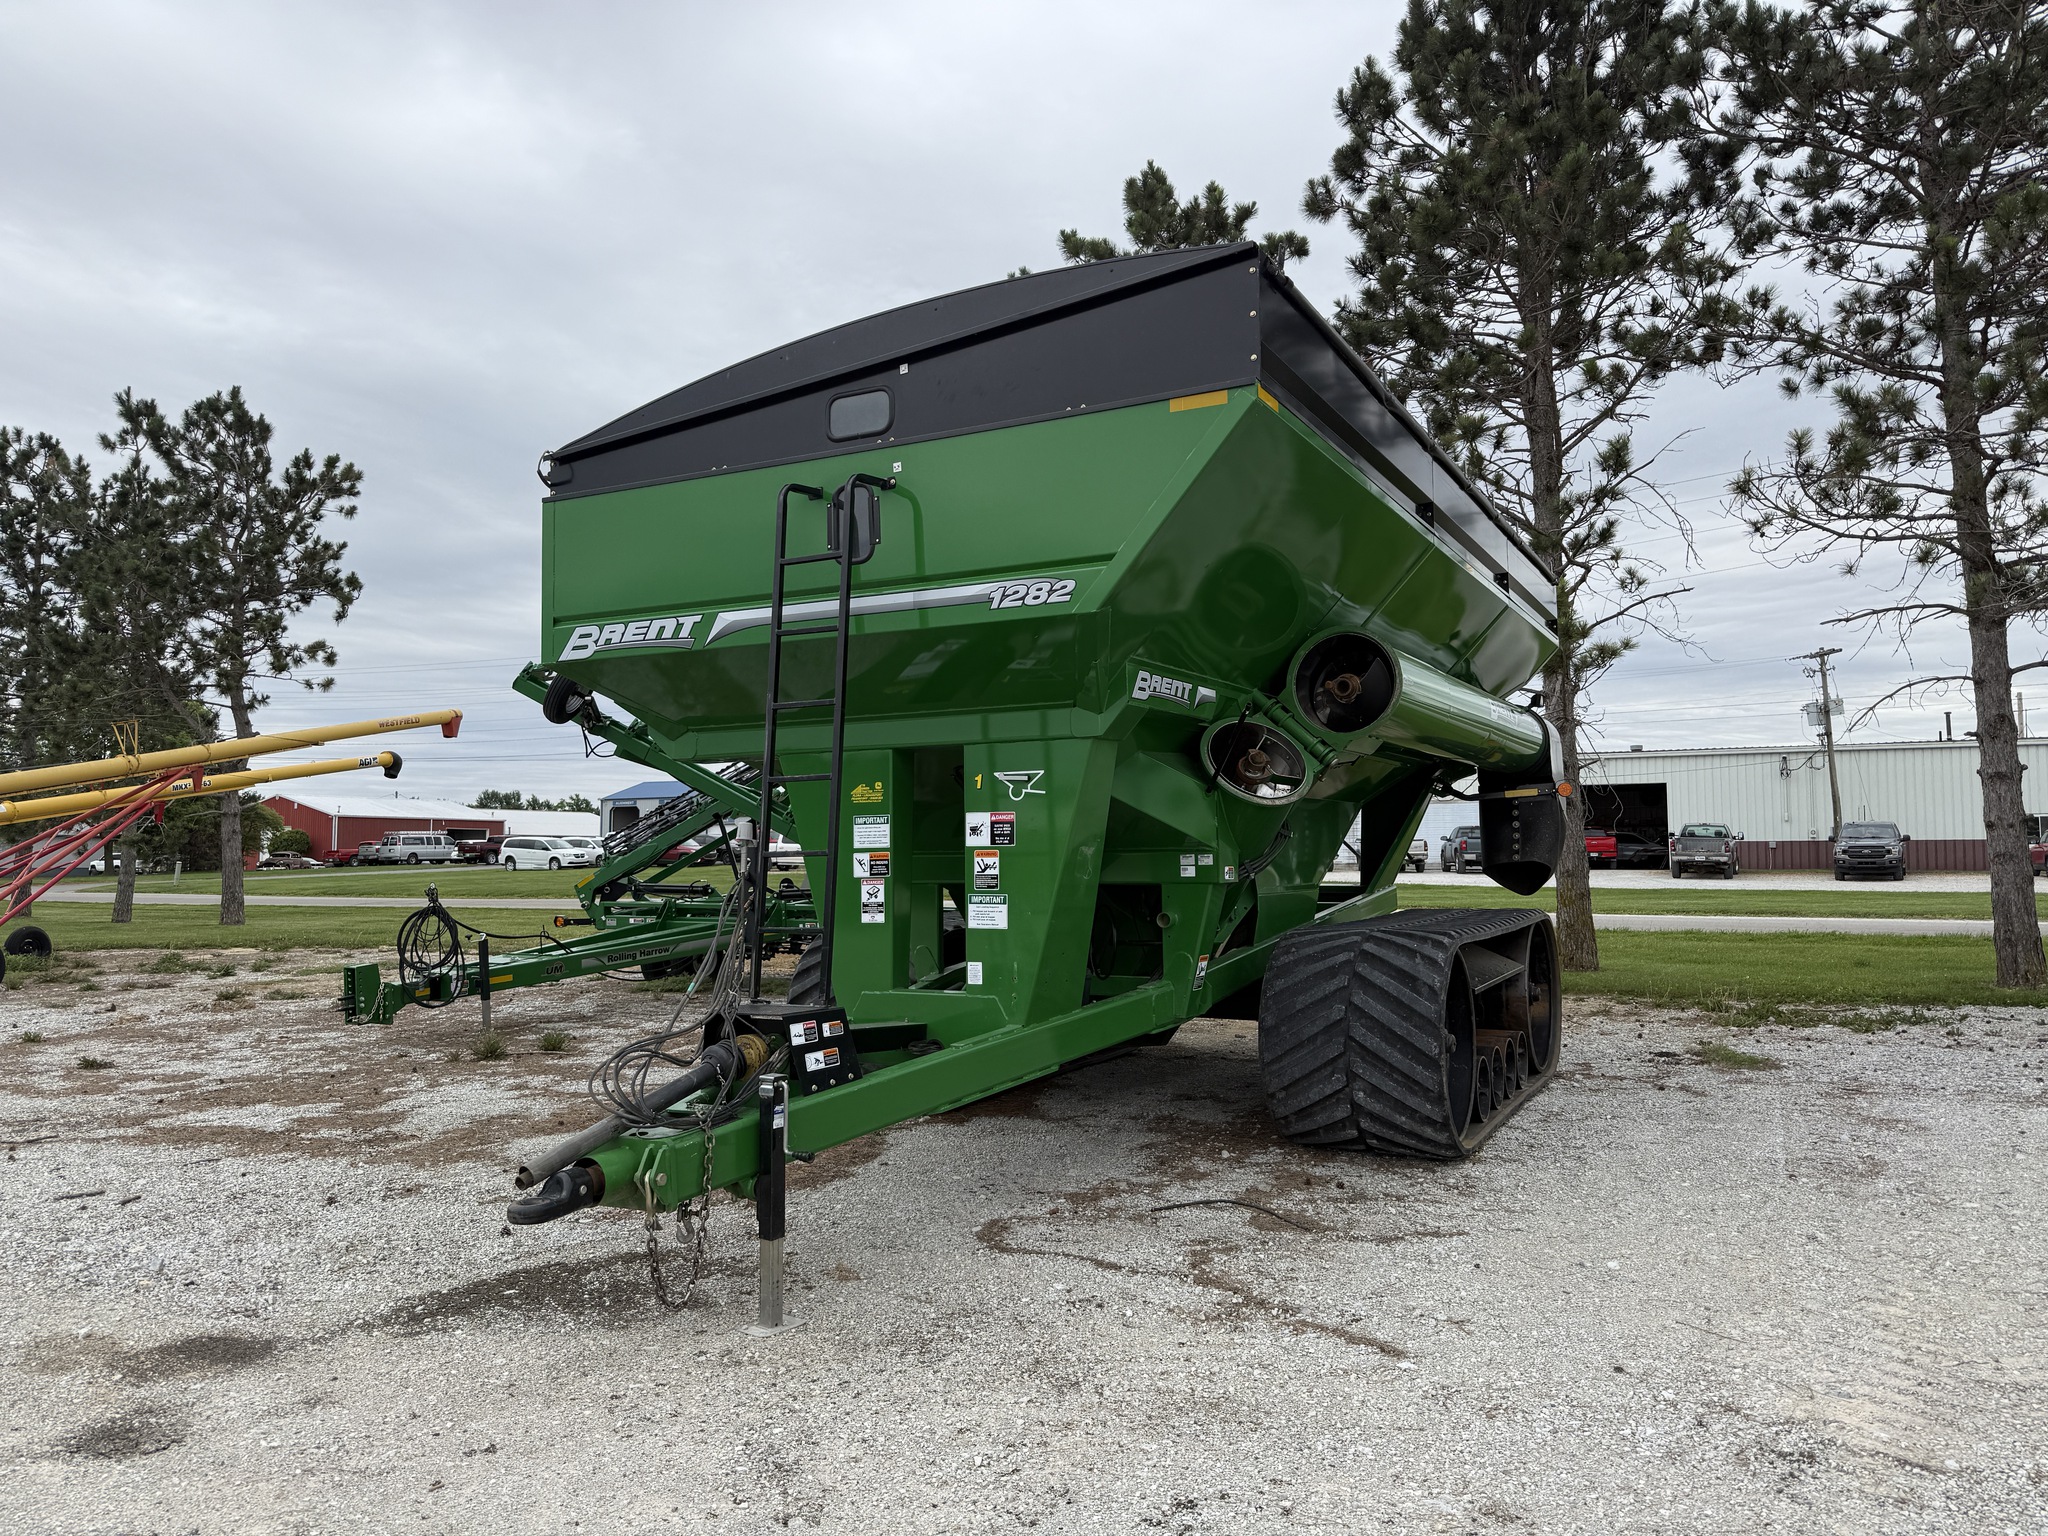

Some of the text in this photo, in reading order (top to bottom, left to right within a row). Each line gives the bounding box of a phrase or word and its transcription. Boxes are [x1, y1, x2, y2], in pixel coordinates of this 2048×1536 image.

[989, 579, 1077, 610] 1282
[557, 614, 703, 662] BRENT
[1131, 669, 1193, 701] BRENT
[378, 716, 420, 728] WESTFIELD
[358, 757, 372, 767] AGI
[974, 773, 982, 789] 1
[855, 816, 888, 825] IMPORTANT
[971, 895, 1005, 904] IMPORTANT
[607, 946, 671, 963] Rolling Harrow
[546, 963, 564, 975] UM
